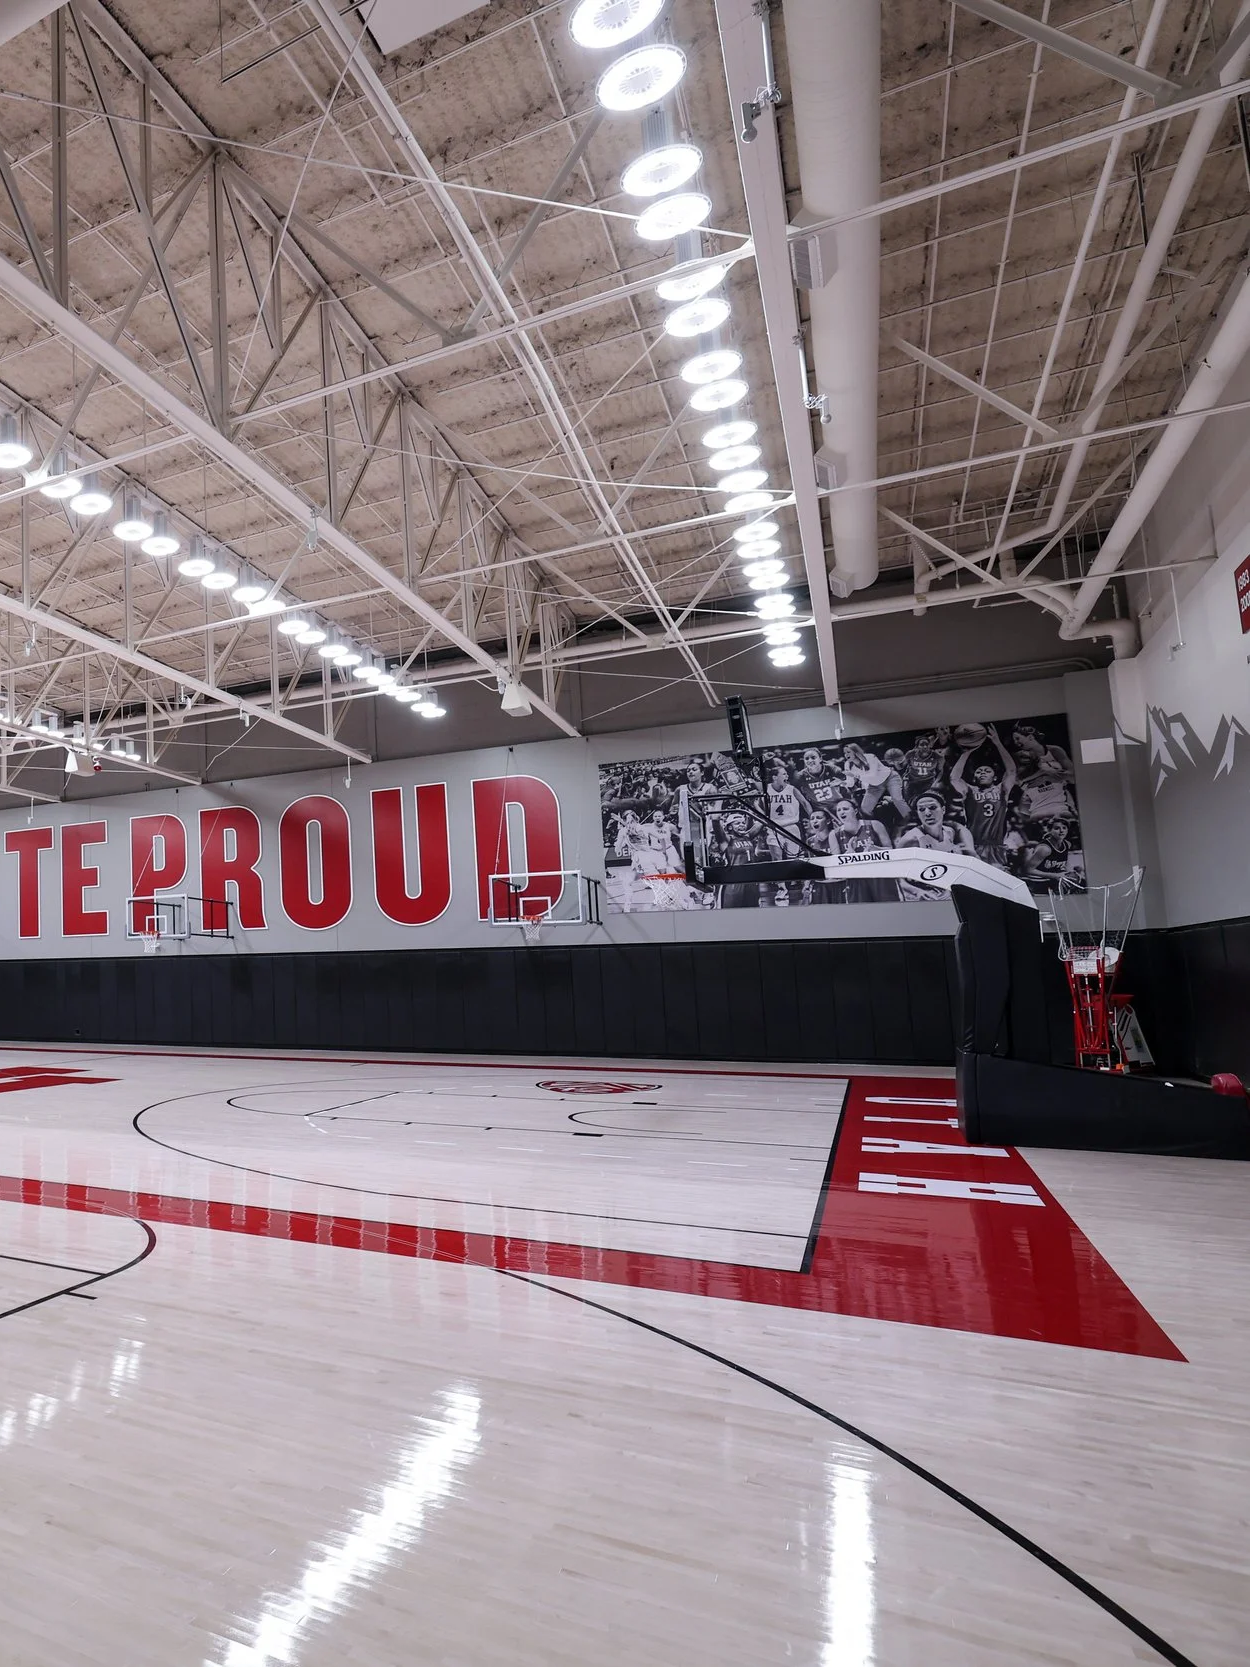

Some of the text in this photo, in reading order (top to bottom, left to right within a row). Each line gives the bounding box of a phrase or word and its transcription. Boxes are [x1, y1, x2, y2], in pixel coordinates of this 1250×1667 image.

[1240, 590, 1250, 613] 200
[768, 794, 792, 804] UTAH
[813, 786, 833, 802] 23
[974, 792, 1000, 801] UTAH
[775, 804, 784, 816] 4
[983, 803, 994, 817] 3
[130, 775, 565, 935] PROUD
[838, 851, 890, 865] SPALDING
